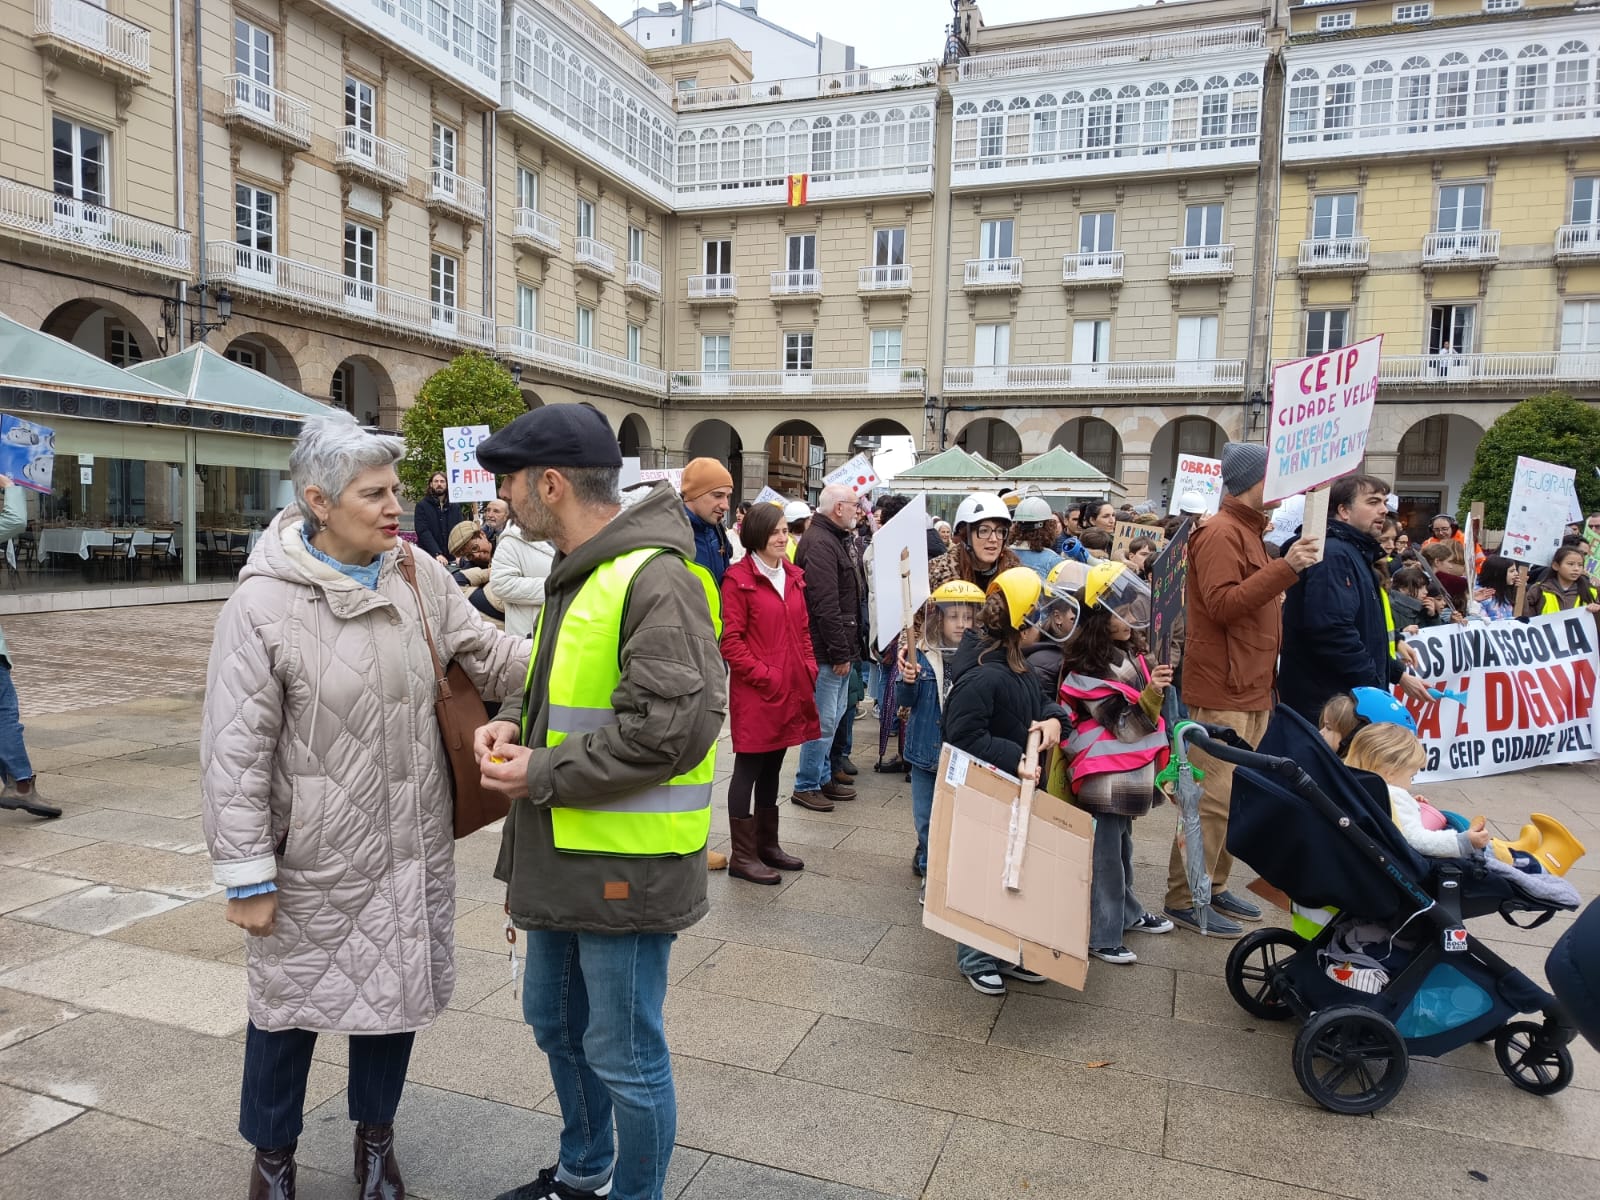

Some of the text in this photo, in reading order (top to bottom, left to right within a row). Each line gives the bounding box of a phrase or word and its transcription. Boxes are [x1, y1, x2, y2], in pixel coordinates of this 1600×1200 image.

[1299, 348, 1359, 395] CEIP
[1278, 375, 1378, 427] CIDADE VELLA
[453, 450, 476, 463] EST
[1275, 417, 1341, 455] QUEREMOS
[1181, 459, 1222, 477] OBRAS
[1515, 467, 1575, 497] MEJORAR
[1405, 636, 1445, 679] OS
[1490, 617, 1593, 667] ESCOLA
[1484, 658, 1597, 733] DIGNA
[1449, 739, 1486, 770] CEIP
[1492, 731, 1556, 764] CIDADE
[1557, 723, 1592, 752] VEL
